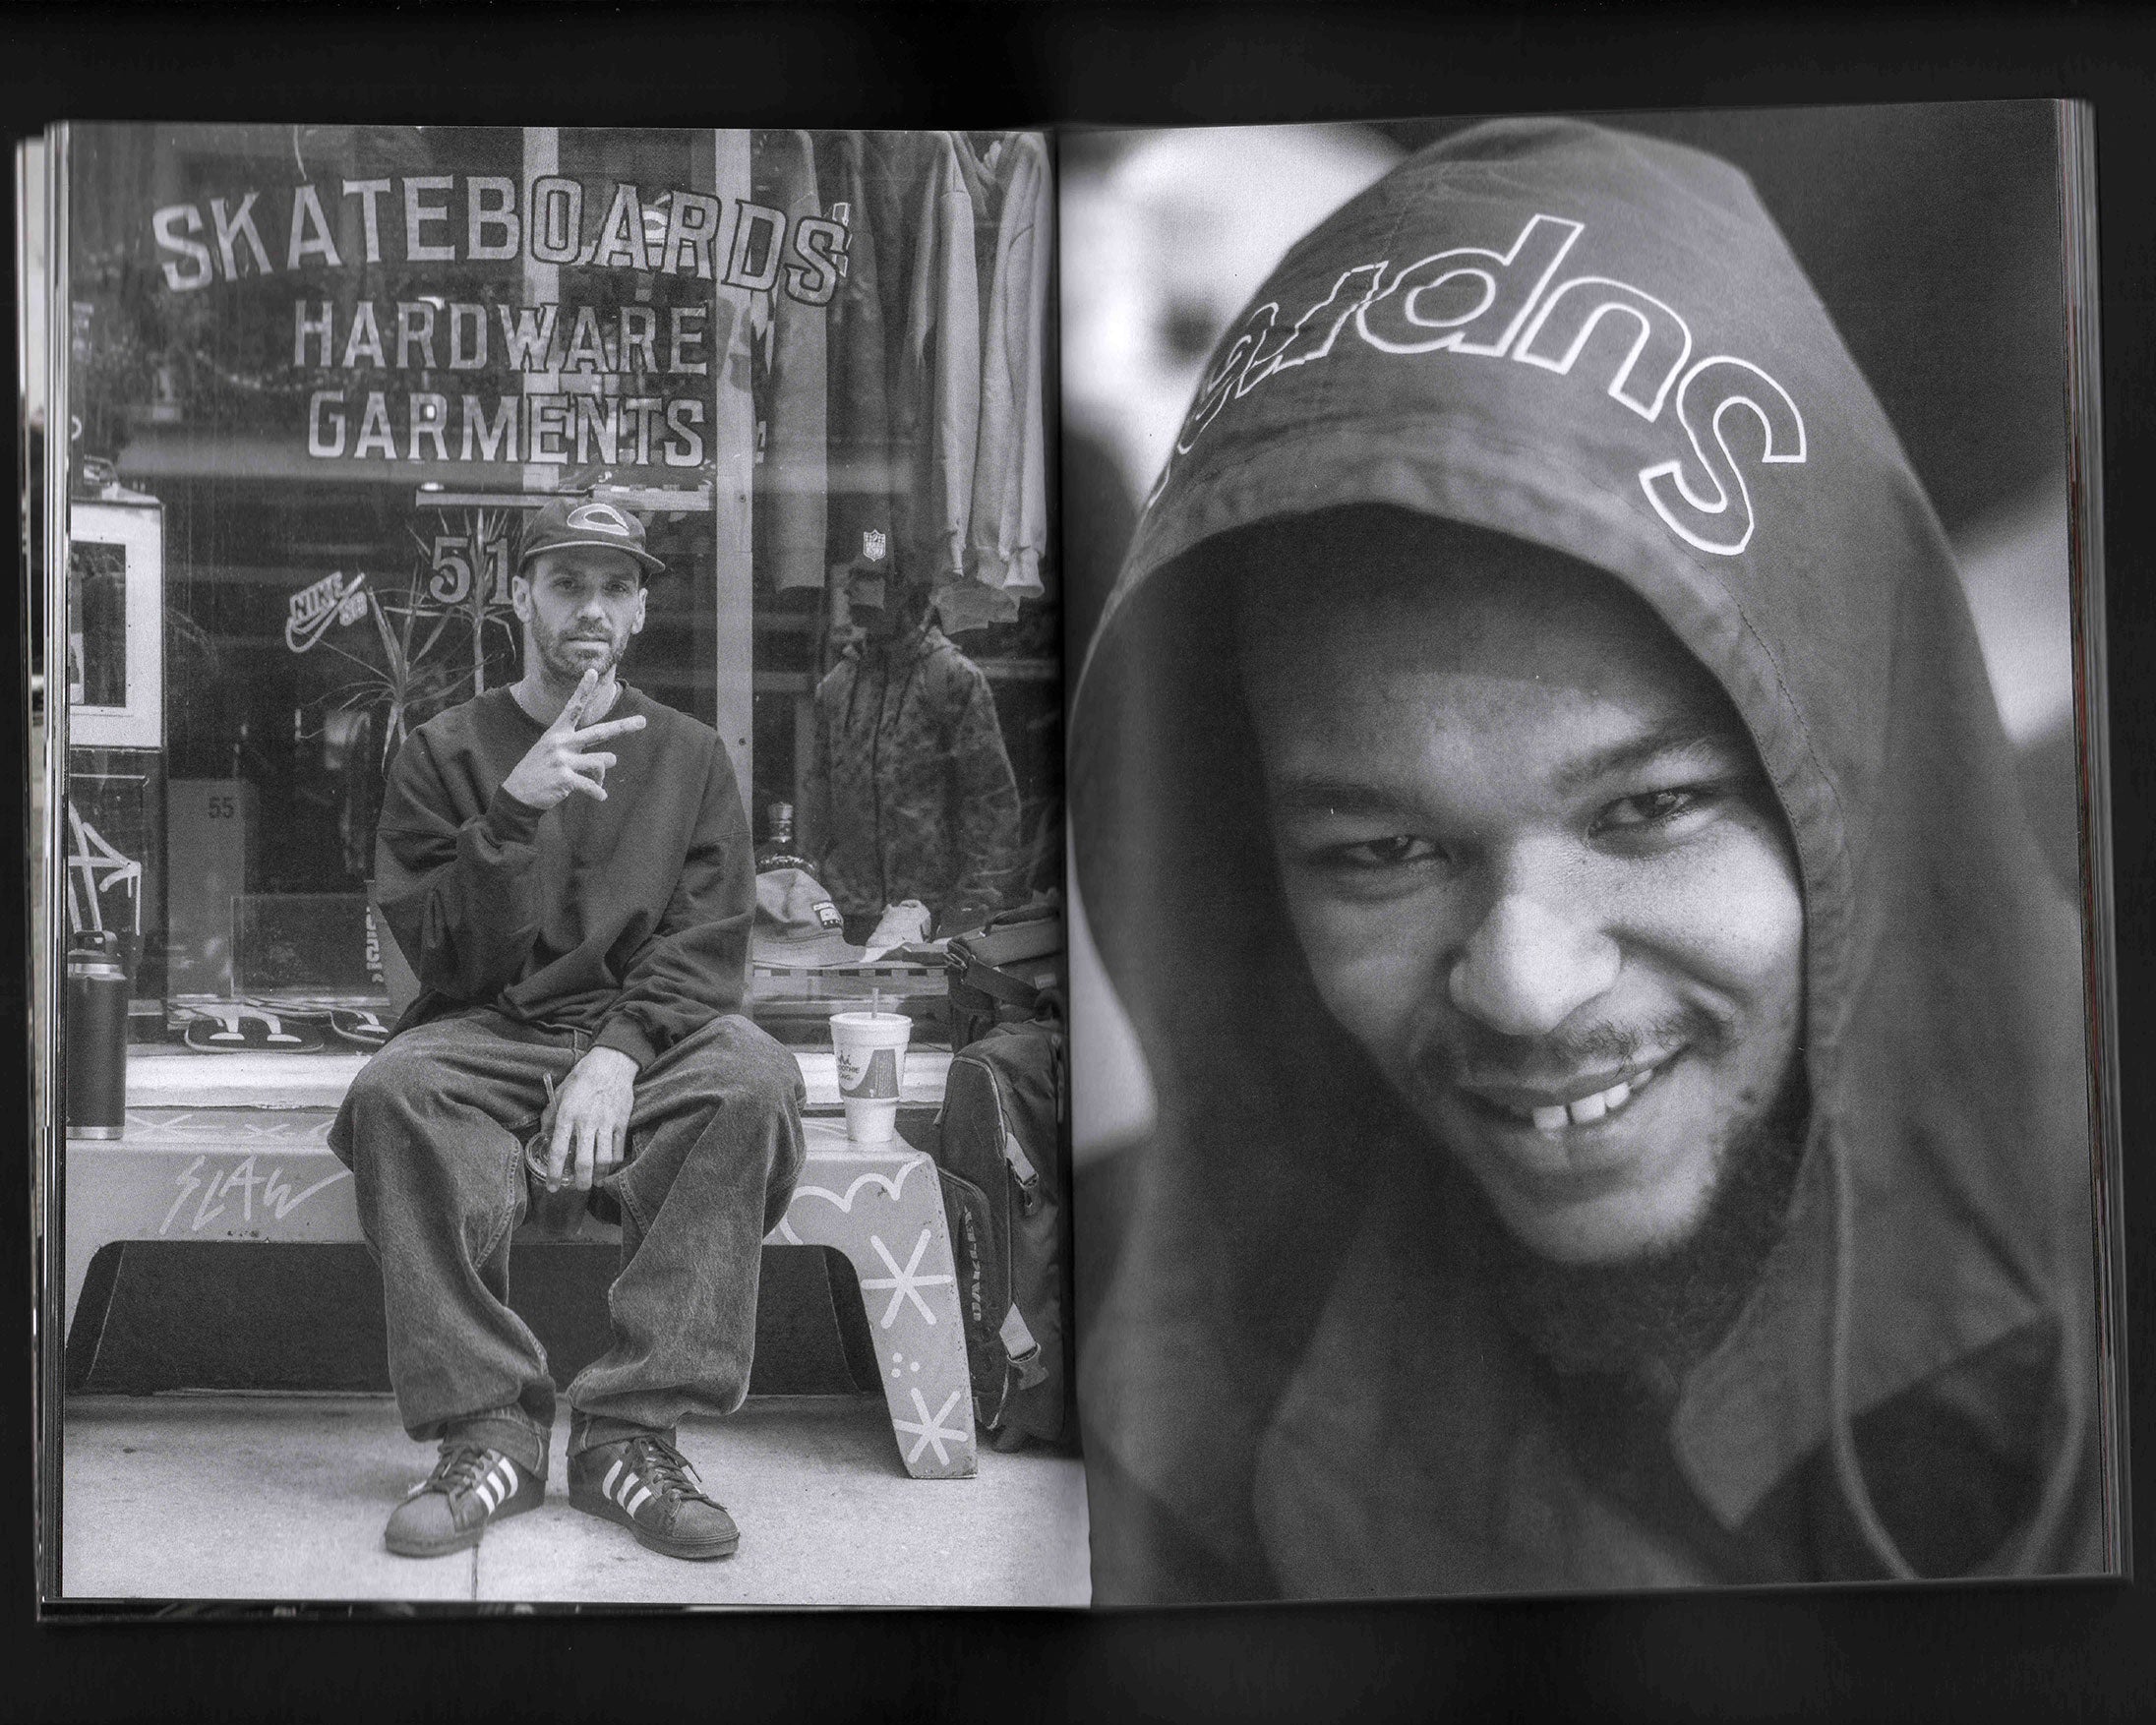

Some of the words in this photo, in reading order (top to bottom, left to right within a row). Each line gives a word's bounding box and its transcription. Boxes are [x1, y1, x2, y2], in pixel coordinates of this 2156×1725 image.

[152, 175, 848, 306] SKATEBOARDS
[294, 299, 708, 375] HARDWARE
[308, 390, 705, 467] GARMENTS
[209, 796, 235, 818] 55
[963, 1205, 982, 1322] OAKLEY
